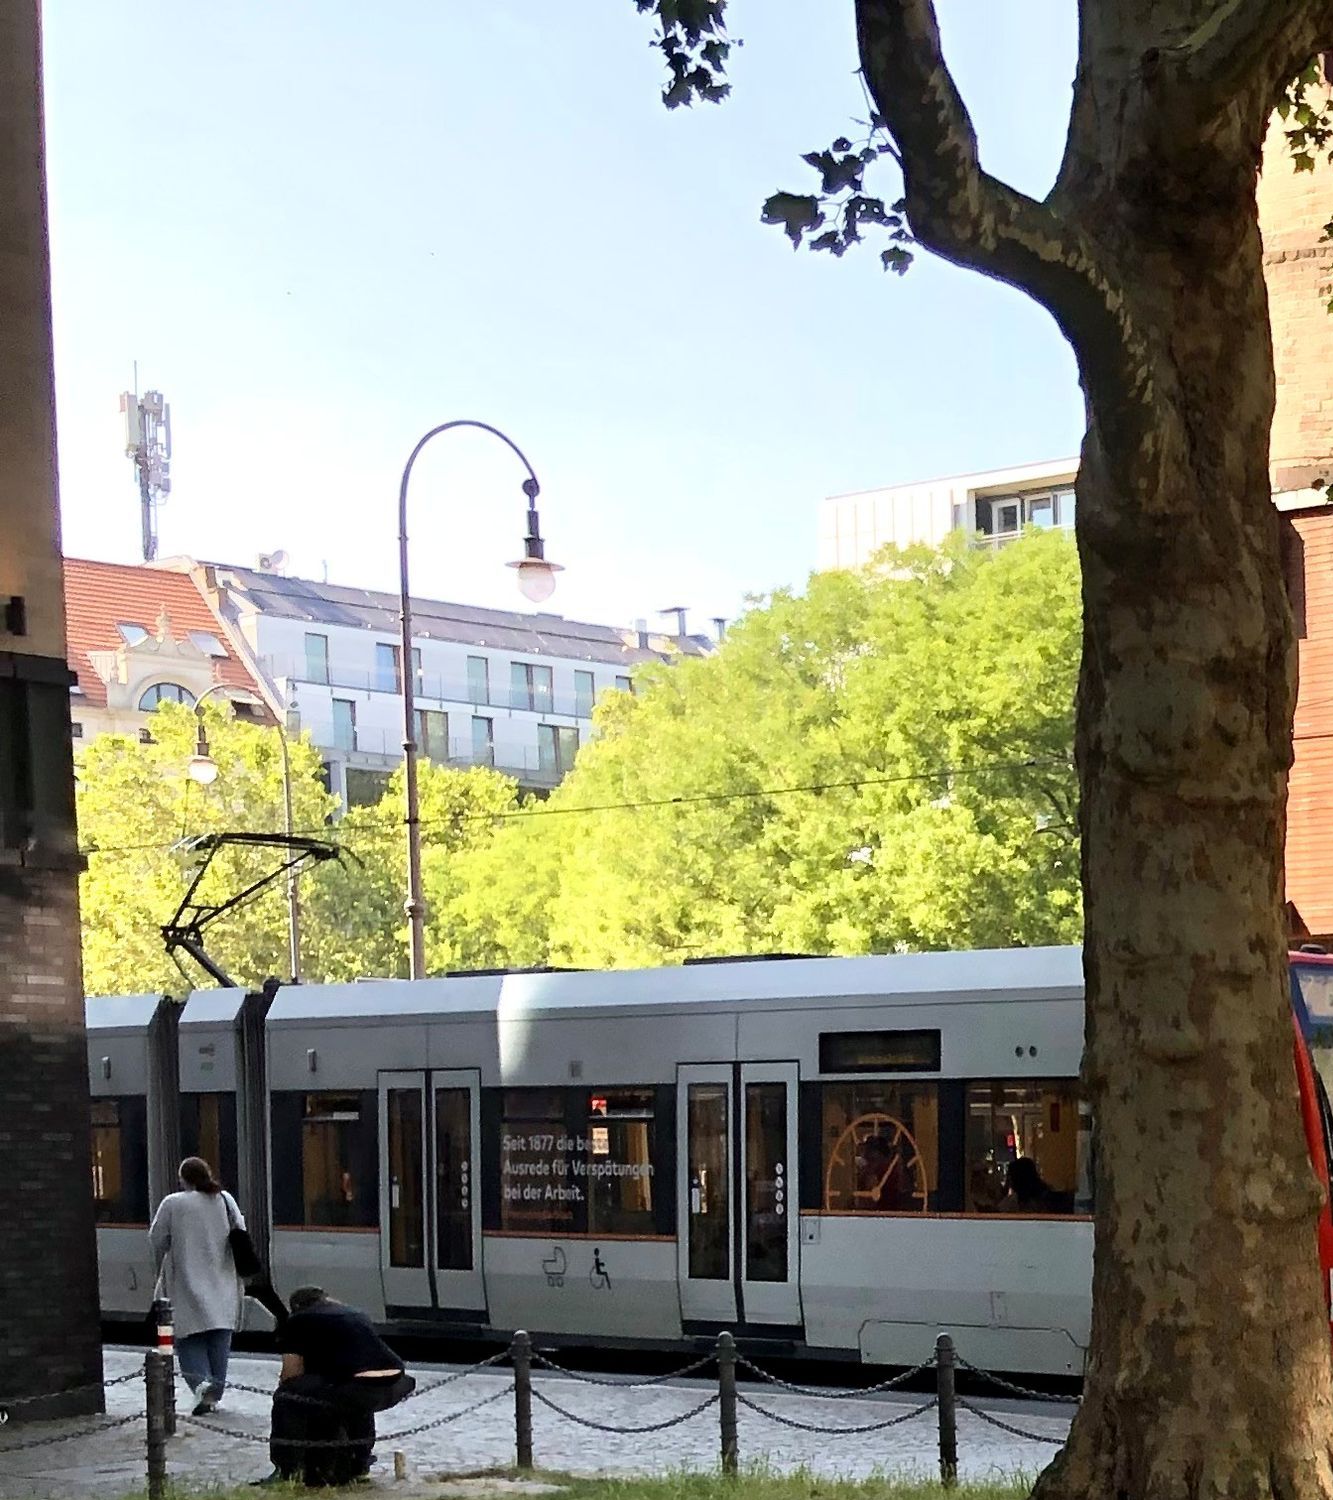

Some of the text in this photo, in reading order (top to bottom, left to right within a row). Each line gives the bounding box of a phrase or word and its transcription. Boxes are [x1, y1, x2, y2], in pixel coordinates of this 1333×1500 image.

[502, 1135, 526, 1150] Seit
[528, 1135, 553, 1150] 1877
[556, 1135, 574, 1150] die
[503, 1159, 654, 1180] Ausrede für Verspätungen
[504, 1184, 584, 1200] bei der Arbeit.
